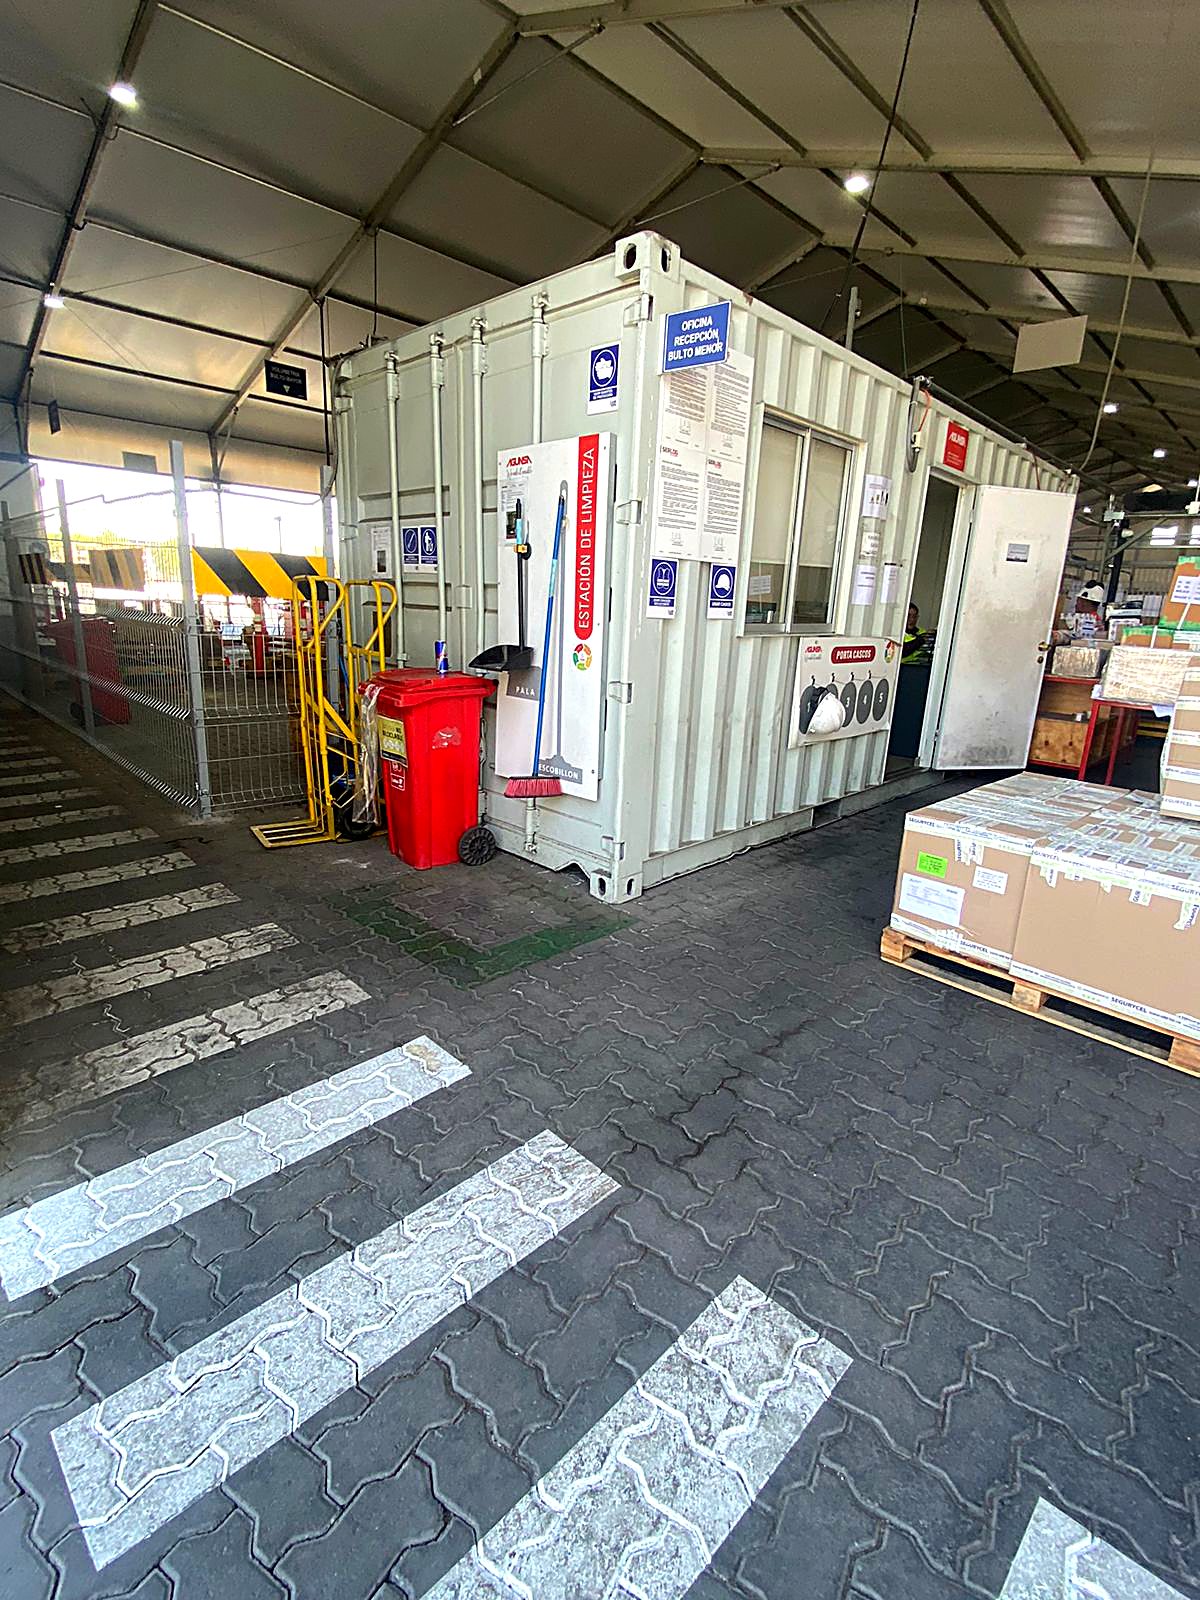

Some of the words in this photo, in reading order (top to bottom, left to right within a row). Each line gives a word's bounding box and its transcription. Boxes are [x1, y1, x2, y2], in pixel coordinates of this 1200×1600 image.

[681, 315, 713, 331] OFICINA
[673, 327, 719, 346] RECEPCIÓN
[668, 347, 694, 361] BULTO
[694, 341, 724, 356] MENOR
[506, 455, 533, 468] AGUNSA
[581, 447, 595, 523] LIMPIEZA
[580, 529, 592, 548] DE
[578, 554, 592, 630] ESTACIÓN
[836, 650, 853, 660] PORTA
[853, 649, 872, 659] CASCOS
[515, 686, 535, 696] PALA
[879, 692, 884, 703] 5
[846, 697, 850, 708] 3
[538, 763, 579, 780] ESCOBILLON
[960, 940, 988, 954] SEGURYCEL
[1111, 996, 1147, 1014] SEGURYCEL
